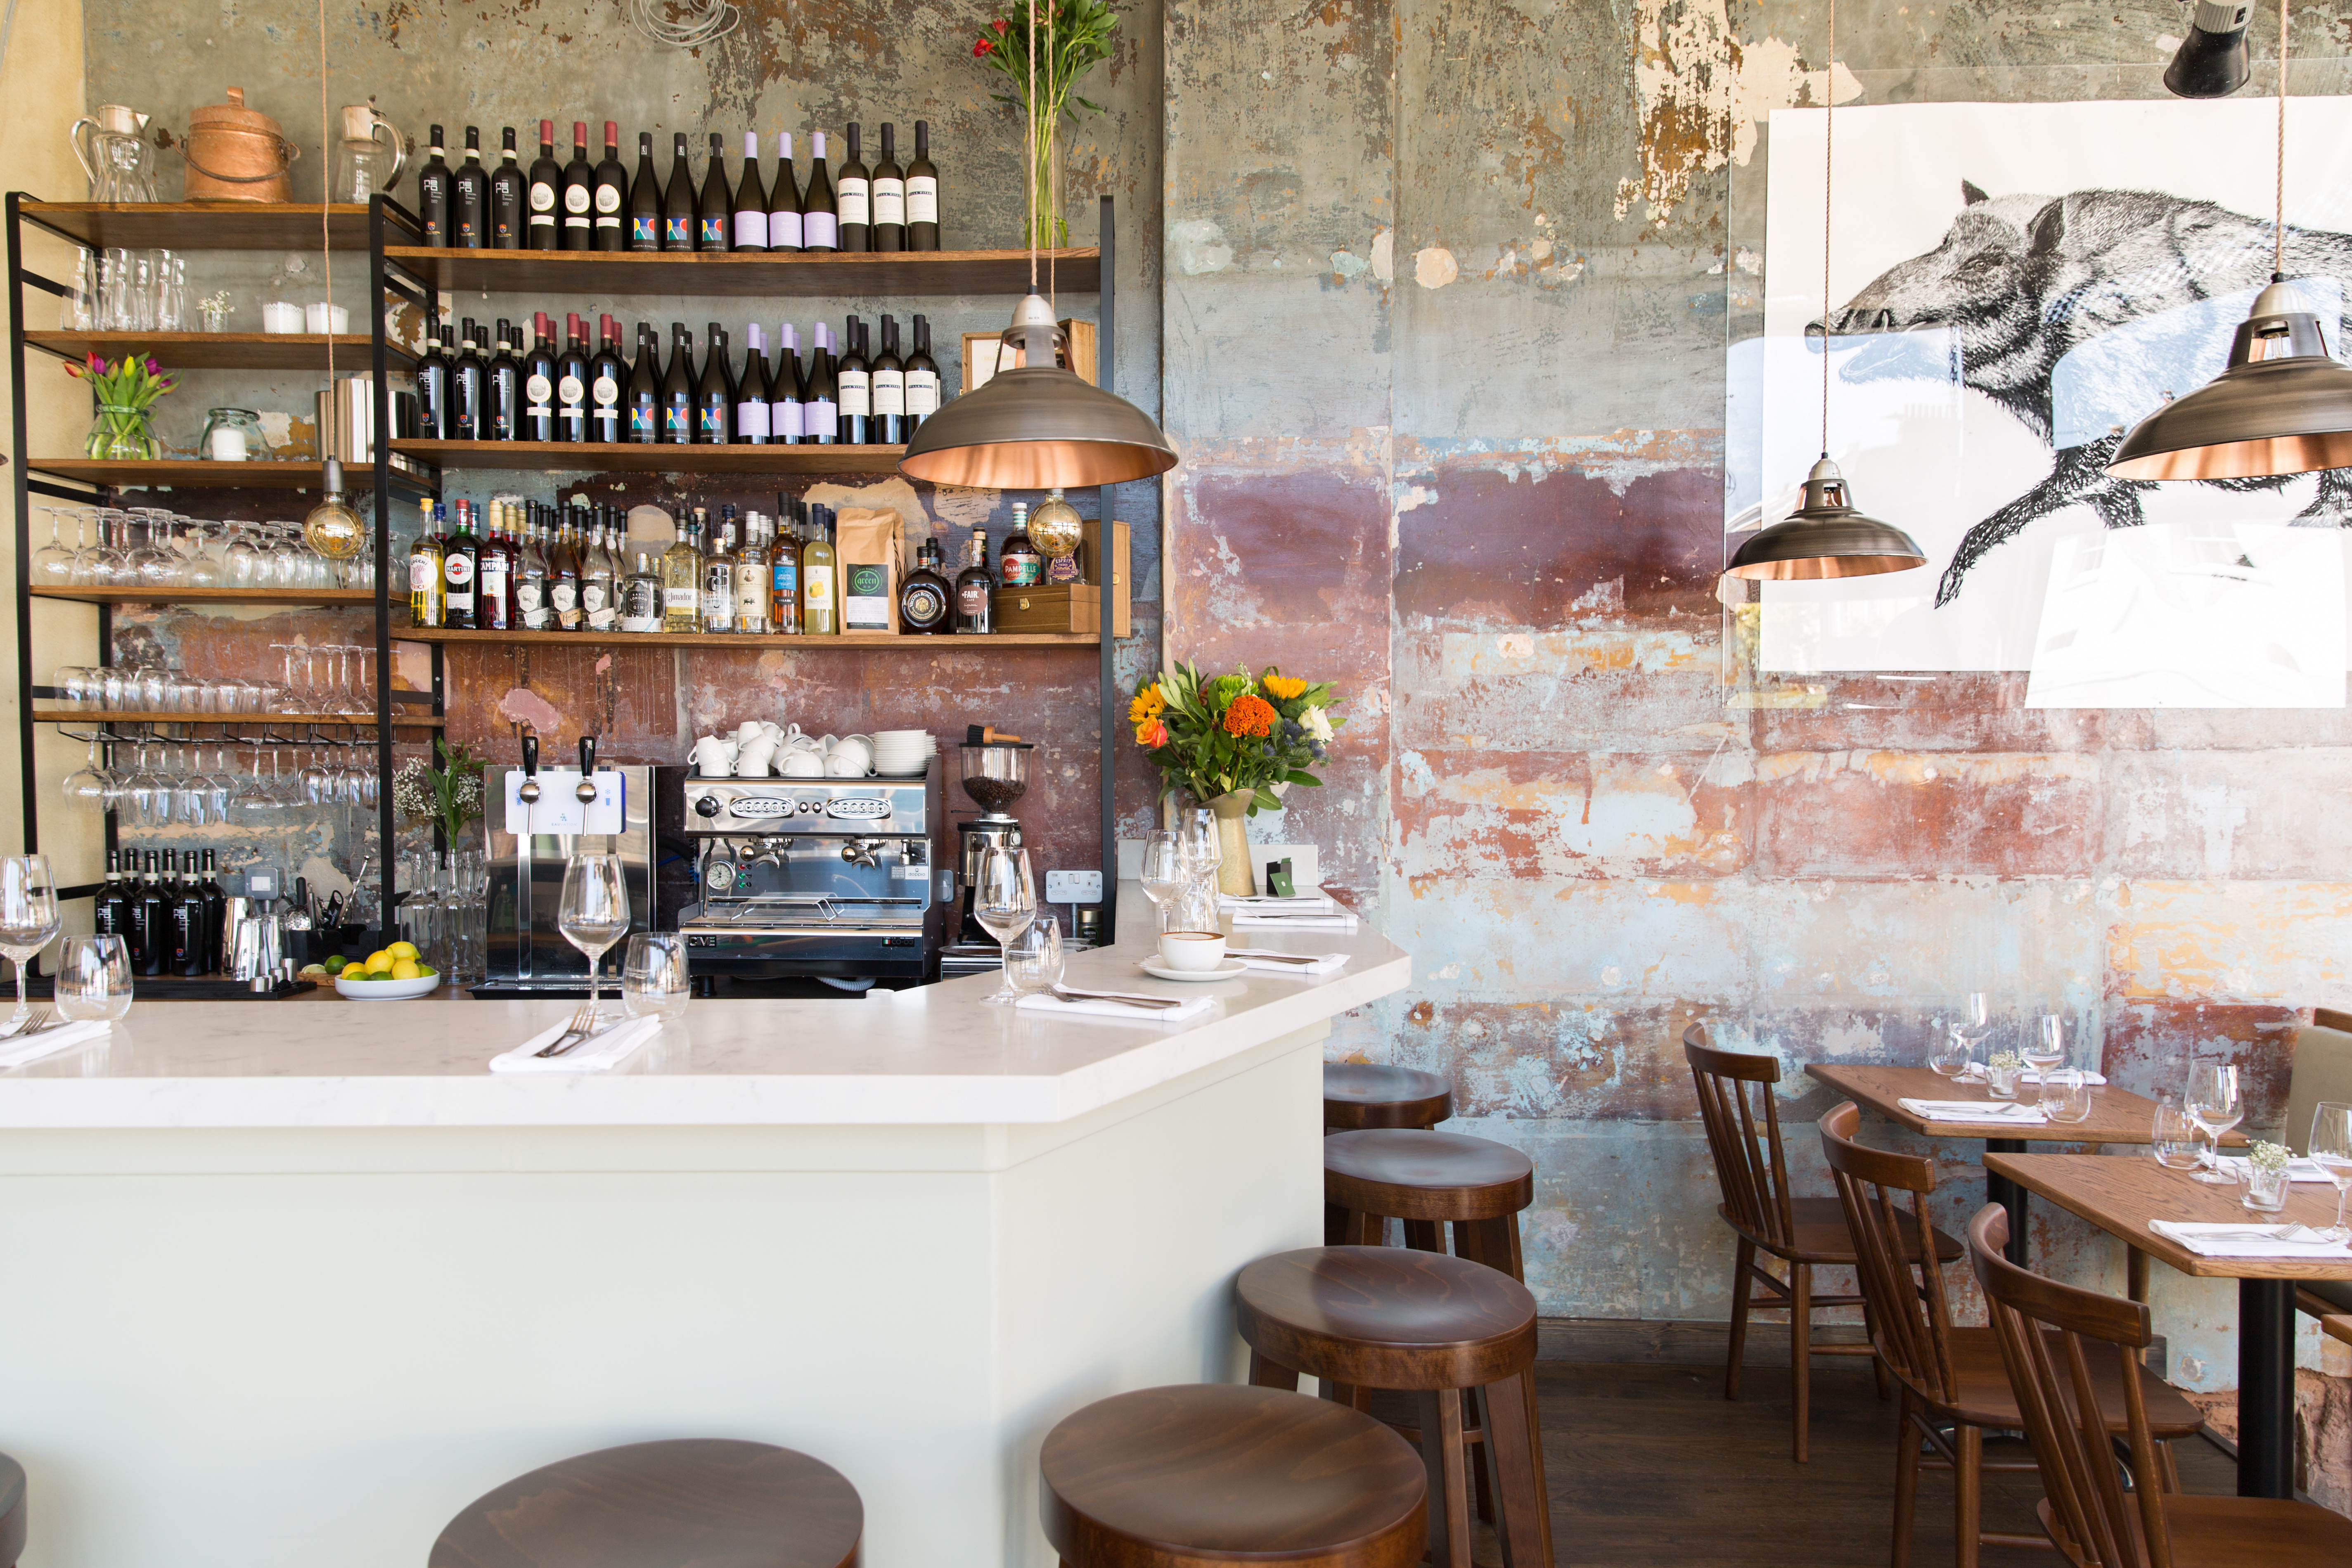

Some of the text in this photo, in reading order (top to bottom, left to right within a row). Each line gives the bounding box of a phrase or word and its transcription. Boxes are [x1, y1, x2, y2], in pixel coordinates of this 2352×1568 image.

[668, 592, 692, 602] Jimador
[910, 592, 935, 607] VECCHIA ROMAGNA
[689, 937, 715, 946] CIME
